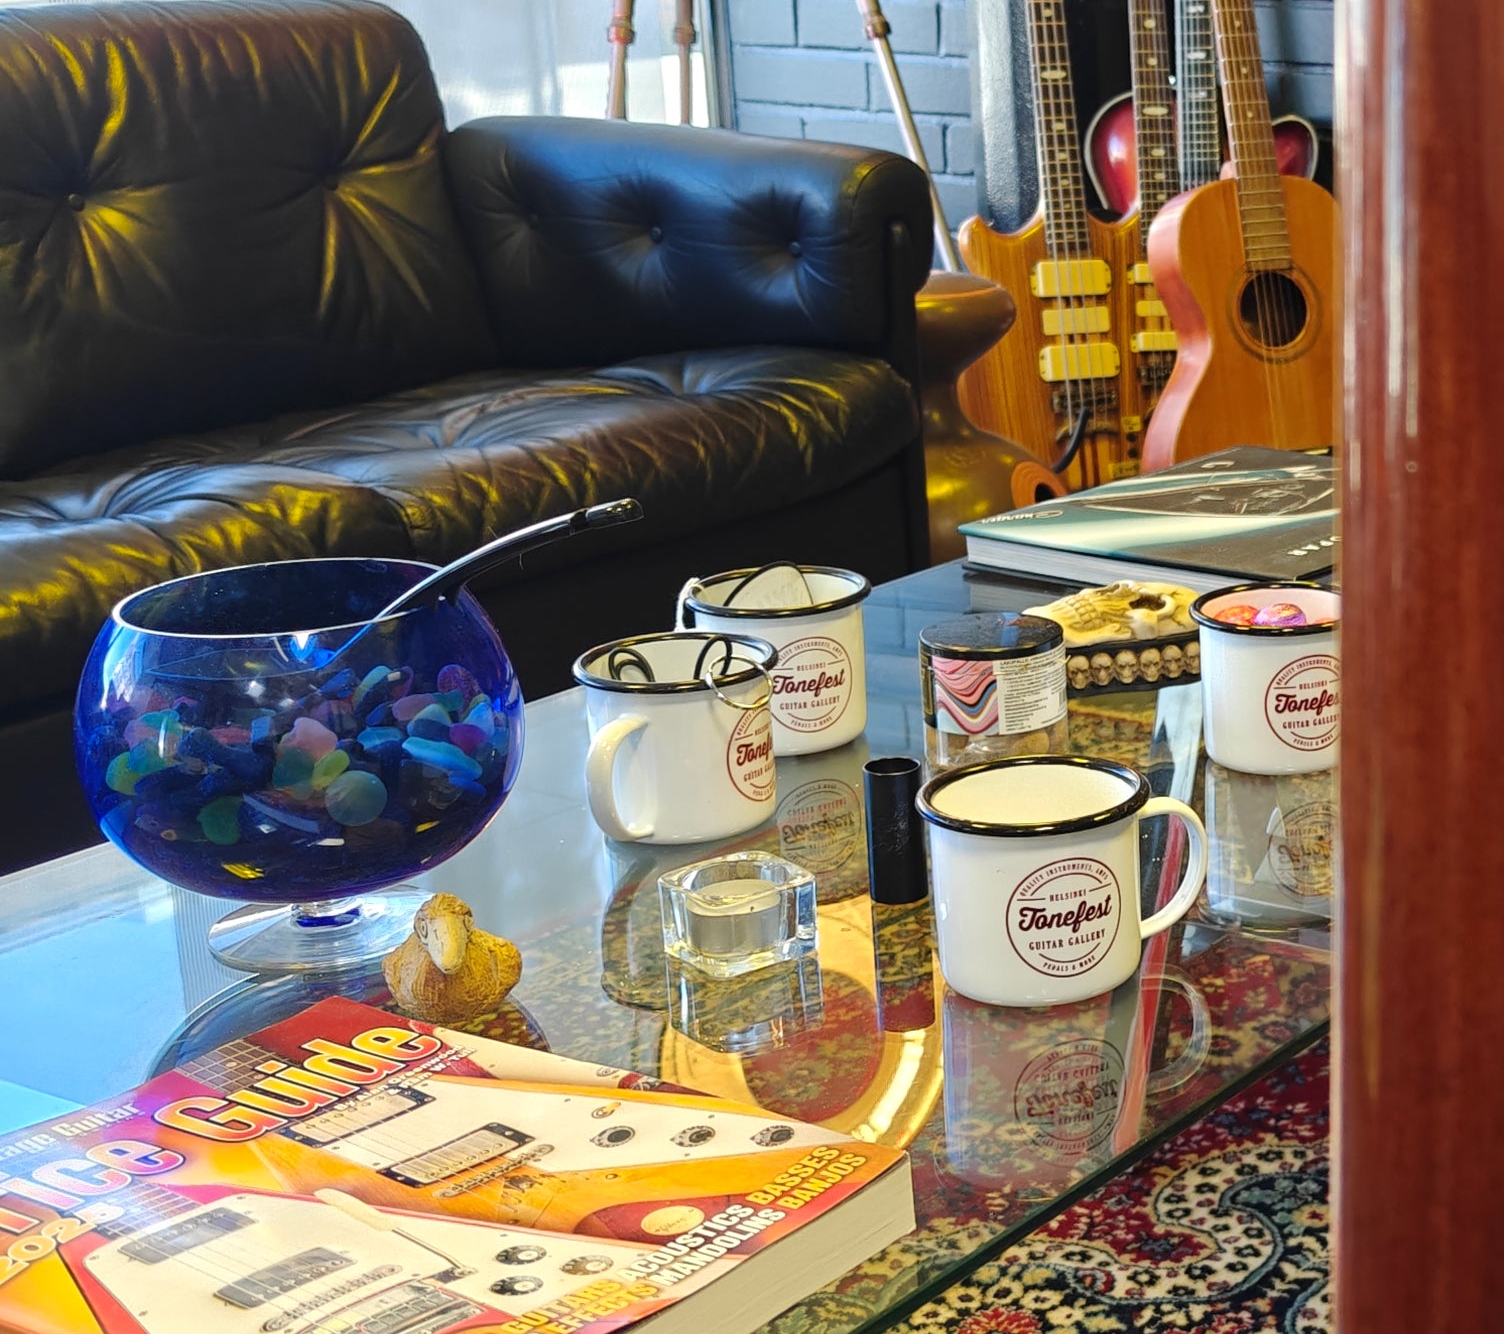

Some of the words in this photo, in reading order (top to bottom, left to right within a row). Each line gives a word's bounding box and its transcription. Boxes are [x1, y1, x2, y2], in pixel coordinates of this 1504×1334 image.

[772, 668, 846, 697] Tonefest
[780, 701, 808, 710] GUITAR
[811, 695, 841, 708] GALLERY
[1282, 720, 1310, 729] GUITAR
[1020, 874, 1044, 896] QUALITY
[1095, 868, 1109, 880] AMPS
[1049, 889, 1087, 902] HELSINKI
[1018, 894, 1112, 933] Tonefest
[1029, 939, 1063, 950] GUITAR
[1068, 928, 1105, 946] GALLERY
[1043, 962, 1068, 972] PEDALS
[1079, 954, 1096, 968] MORE
[153, 1026, 443, 1143] Guide
[333, 1099, 356, 1111] By
[356, 1084, 390, 1101] Alan
[388, 1044, 465, 1085] Greenwood
[398, 1072, 433, 1088] Ram
[51, 1101, 141, 1137] Guitar
[616, 1204, 754, 1282] ACOUSTICS
[745, 1145, 840, 1205] BASSES
[652, 1208, 786, 1286] MANDOLINS
[777, 1153, 867, 1210] BANJOS
